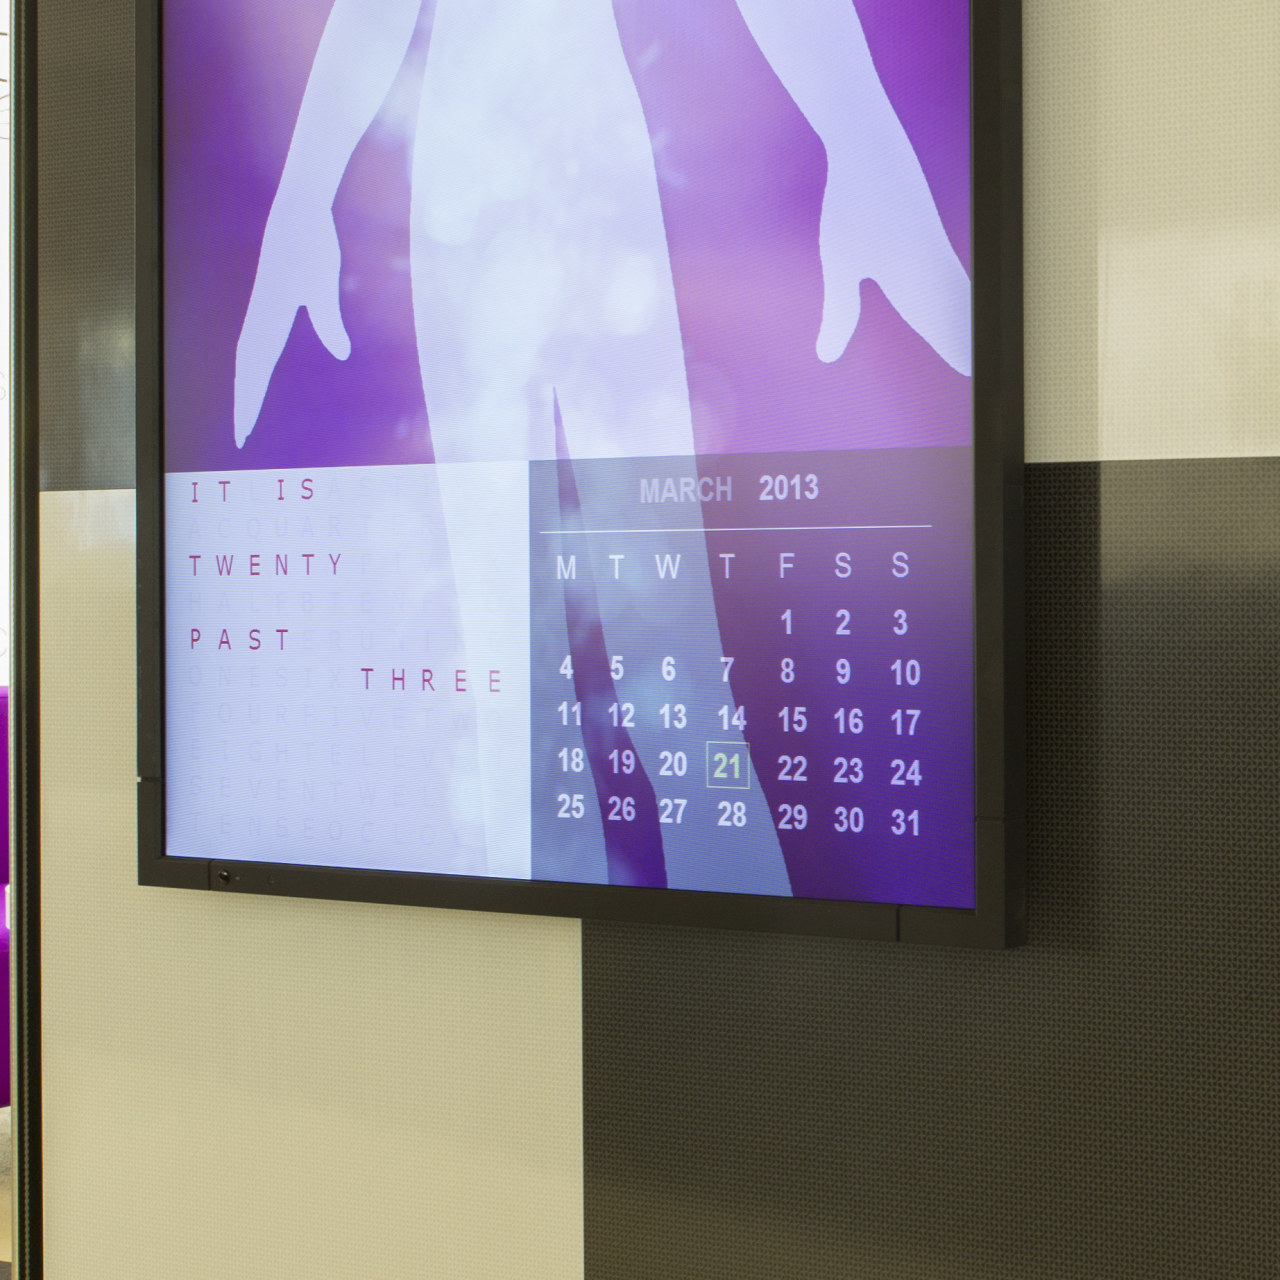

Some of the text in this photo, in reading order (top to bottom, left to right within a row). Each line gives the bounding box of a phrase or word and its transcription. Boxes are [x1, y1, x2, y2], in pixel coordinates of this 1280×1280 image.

[191, 478, 314, 503] IT IS
[640, 474, 819, 503] MARCH 2013
[188, 553, 342, 577] TWENTY
[557, 552, 909, 579] M T W T F S S
[781, 609, 908, 635] 1 2 3
[190, 629, 289, 650] PAST
[361, 668, 501, 693] THREE
[560, 656, 921, 685] 4 5 6 7 8 9 10
[558, 702, 921, 735] 11 12 13 14 15 16 17
[558, 748, 922, 786] 18 19 20 21 22 23 24
[557, 794, 920, 836] 25 26 27 28 29 30 31
